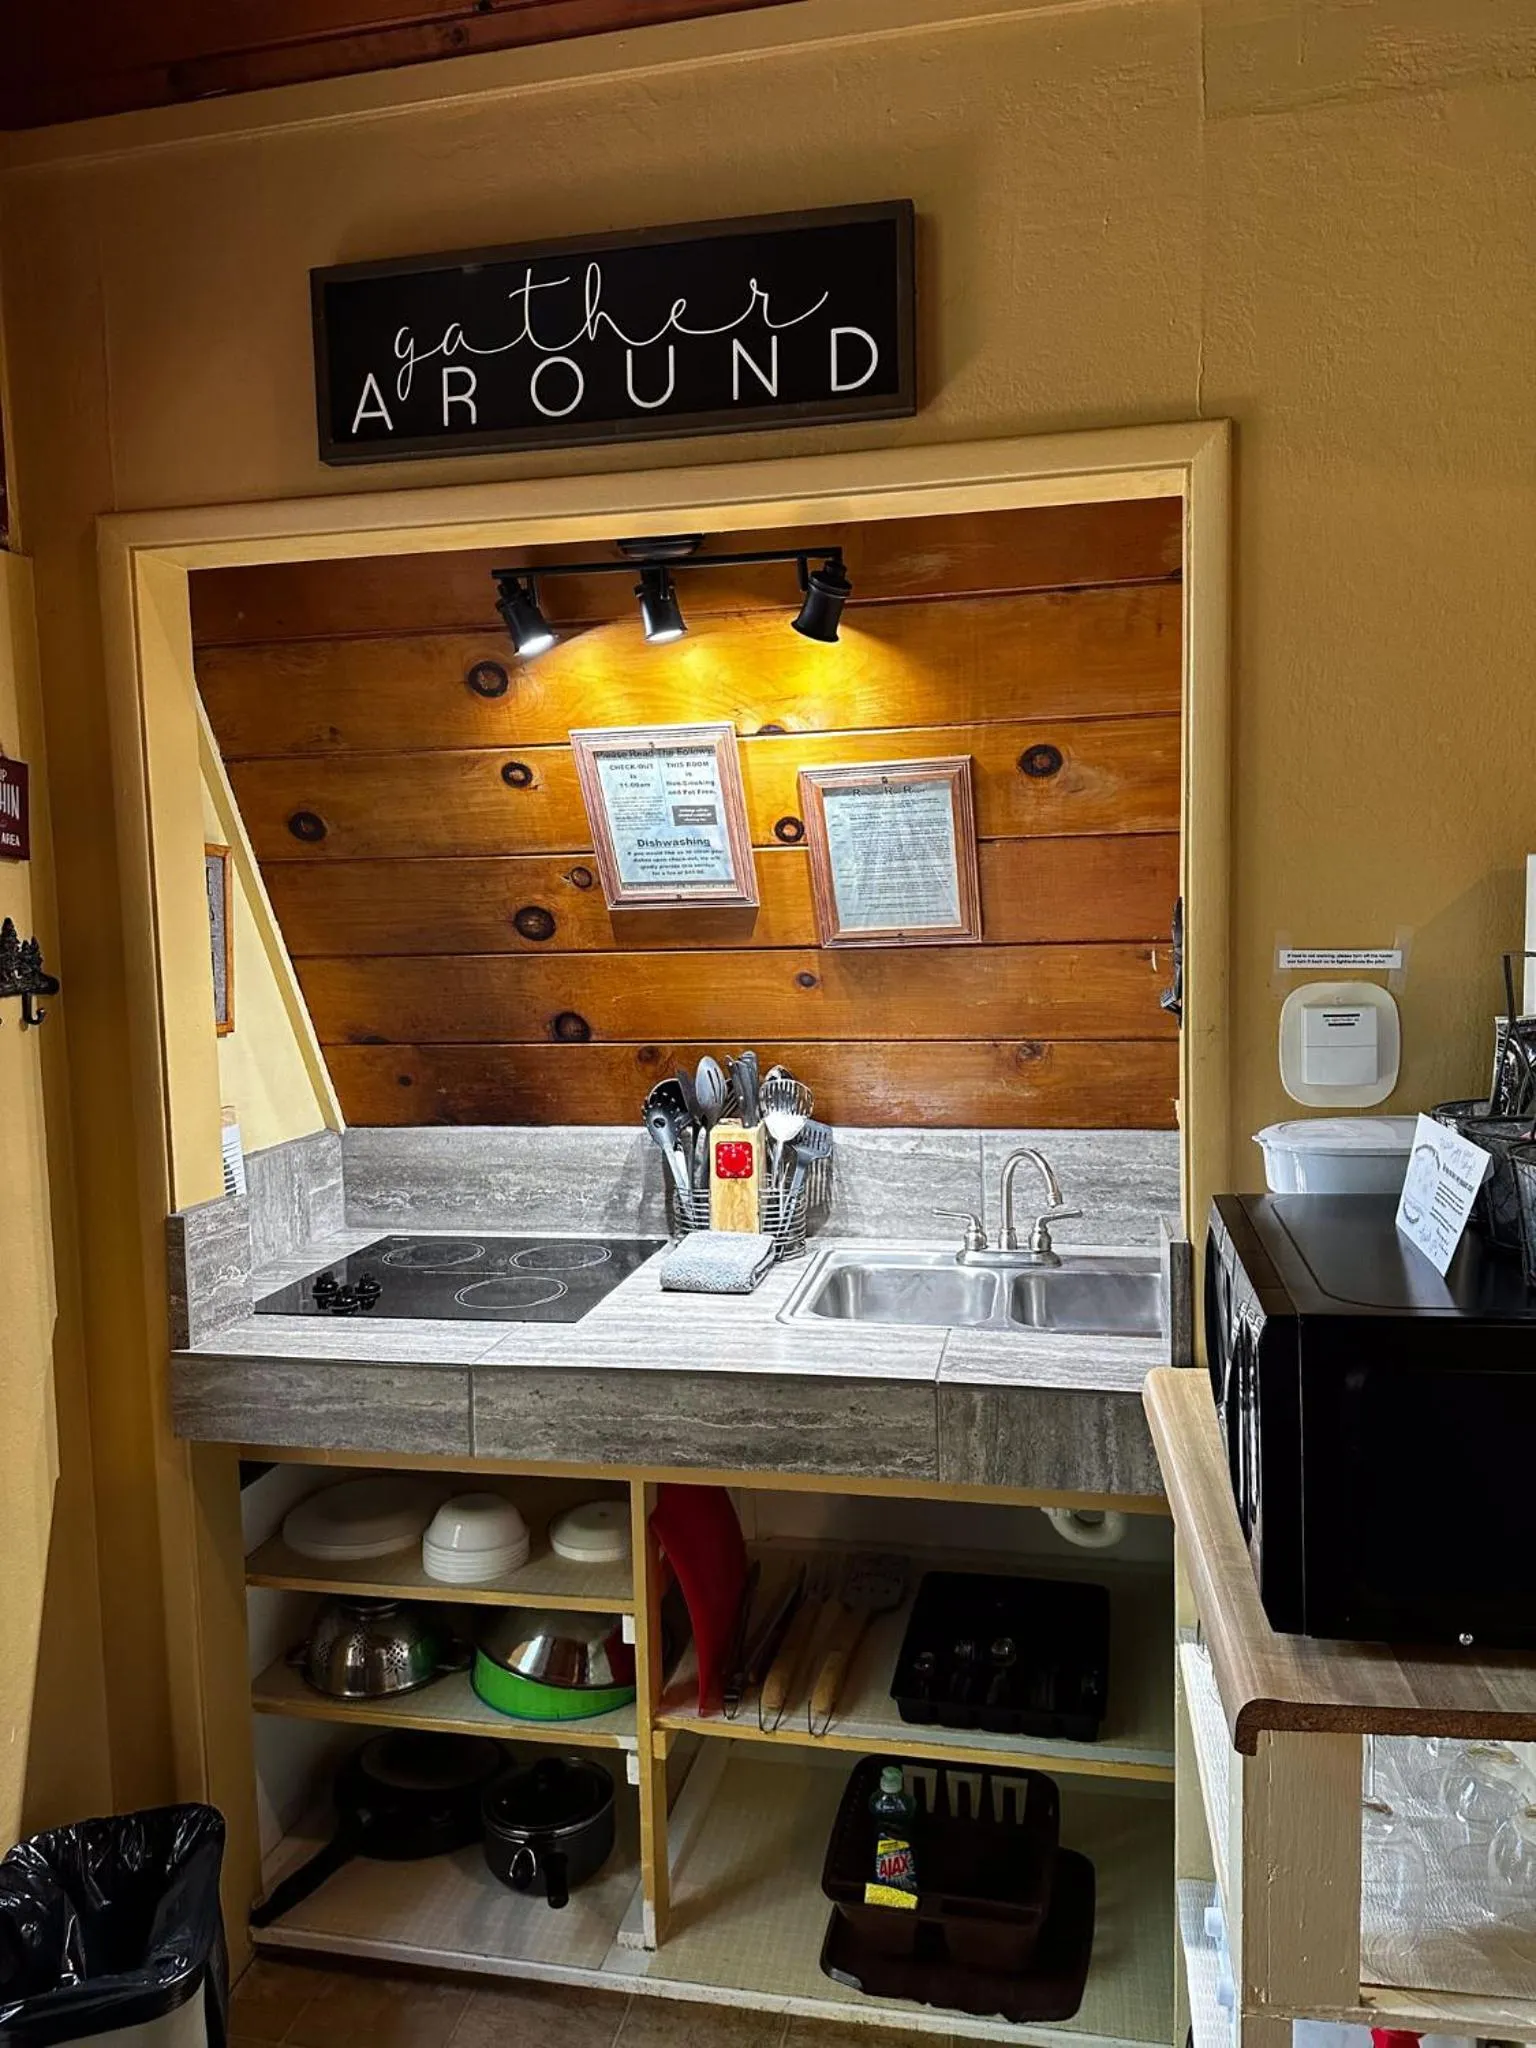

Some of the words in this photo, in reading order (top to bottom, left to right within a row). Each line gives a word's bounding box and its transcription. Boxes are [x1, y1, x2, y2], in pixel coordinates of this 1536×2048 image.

[394, 262, 829, 401] gather
[351, 326, 879, 434] AROUND
[609, 763, 654, 771] CHECK-OUT
[666, 761, 685, 769] THIS
[1, 832, 21, 847] AREA
[637, 837, 711, 848] Dishwashing
[879, 1854, 908, 1878] AJAX
